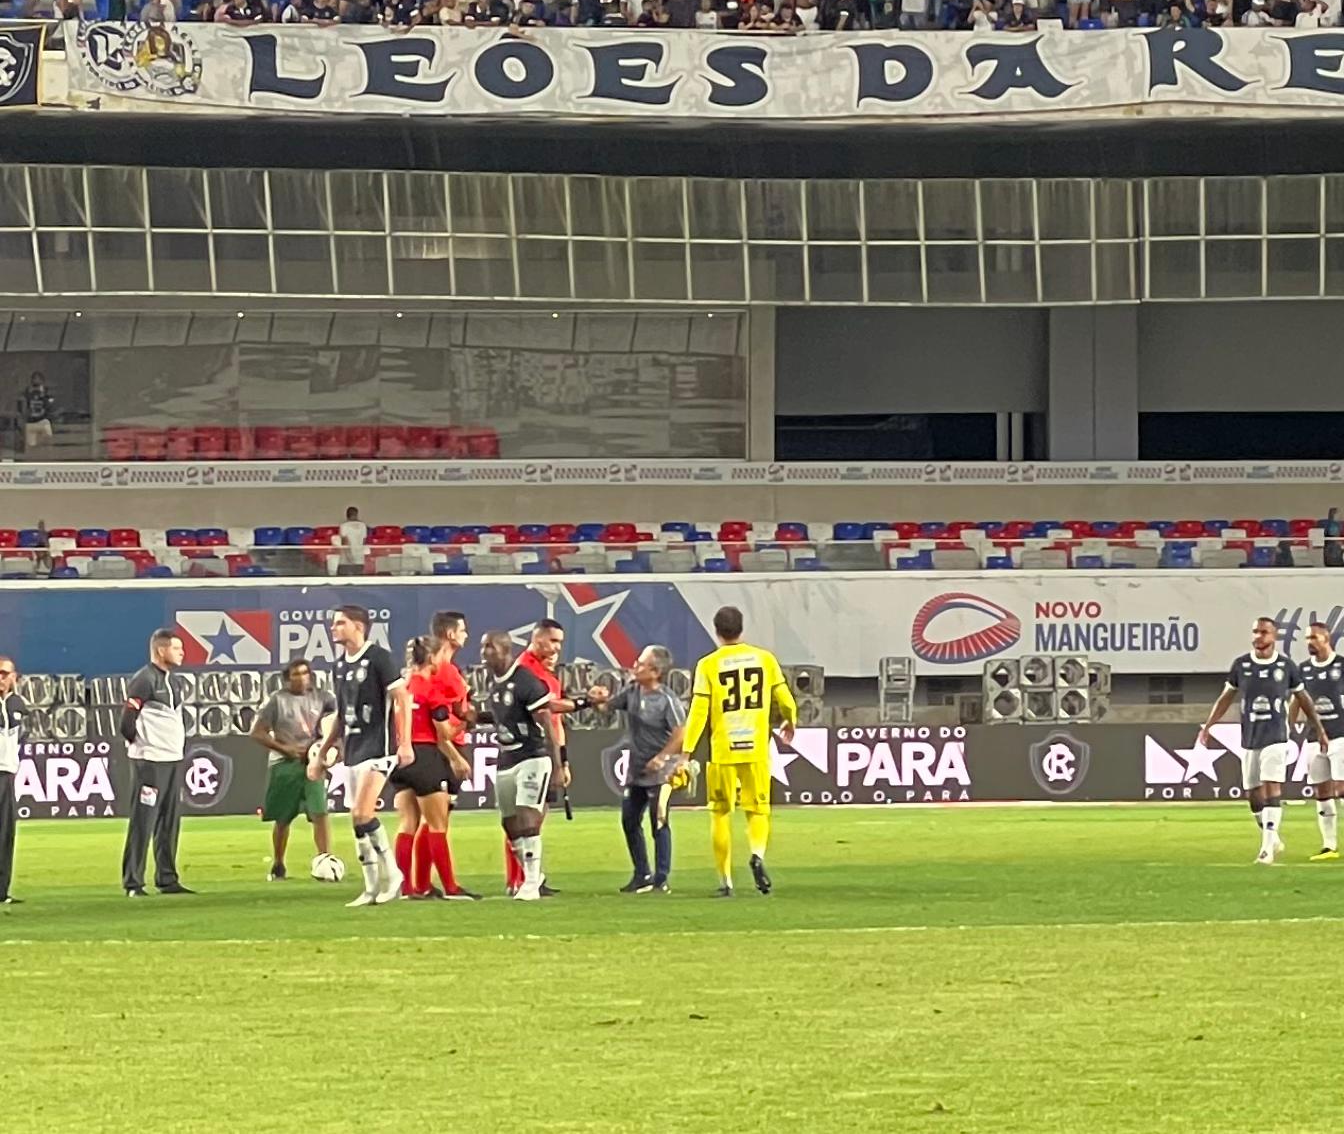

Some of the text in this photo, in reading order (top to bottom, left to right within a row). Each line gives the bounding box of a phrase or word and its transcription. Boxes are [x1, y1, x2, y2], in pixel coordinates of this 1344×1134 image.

[838, 34, 1084, 108] DA
[1035, 602, 1102, 619] NOVO
[280, 622, 391, 664] PAÁ
[1035, 616, 1199, 652] MANGUEIRÃO
[719, 667, 764, 713] 33
[84, 742, 110, 754] DO
[837, 727, 967, 740] GOVERNO DO
[14, 758, 115, 802] ARÁ
[1145, 786, 1192, 798] POR
